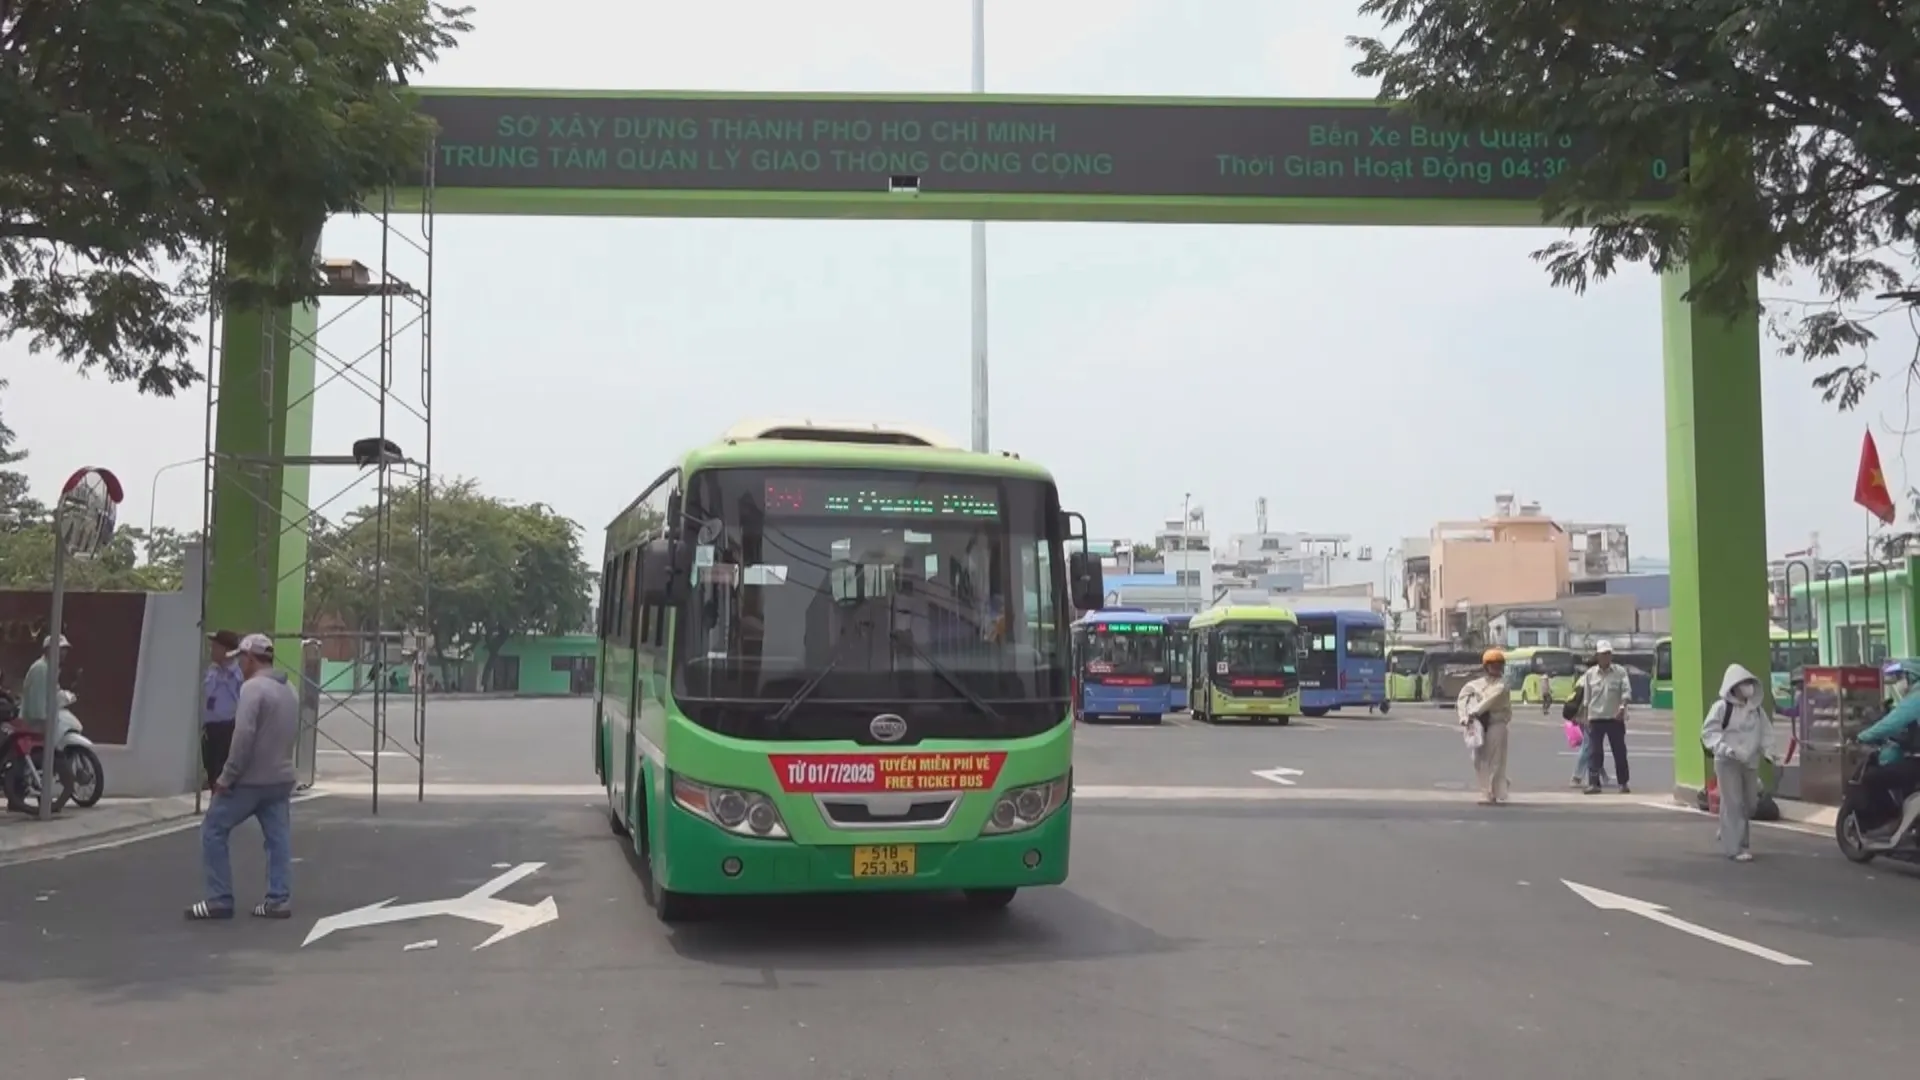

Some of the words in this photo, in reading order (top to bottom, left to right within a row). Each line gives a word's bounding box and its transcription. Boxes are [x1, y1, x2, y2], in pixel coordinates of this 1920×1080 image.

[614, 116, 698, 144] DỰNG
[987, 120, 1056, 143] MINH
[1369, 125, 1402, 147] Xe
[441, 145, 540, 168] TRUNG
[547, 142, 607, 169] TÂM
[752, 148, 821, 171] GIAO
[1284, 155, 1344, 177] Gian
[1353, 156, 1414, 184] Hoạt
[1422, 157, 1492, 184] Động
[953, 755, 973, 770] PHÍ
[808, 763, 875, 784] 01/7/2026
[885, 775, 914, 789] FREE
[917, 775, 957, 788] TICKET
[959, 774, 983, 787] BUS
[871, 846, 898, 860] 51B
[860, 860, 909, 875] 253.35
